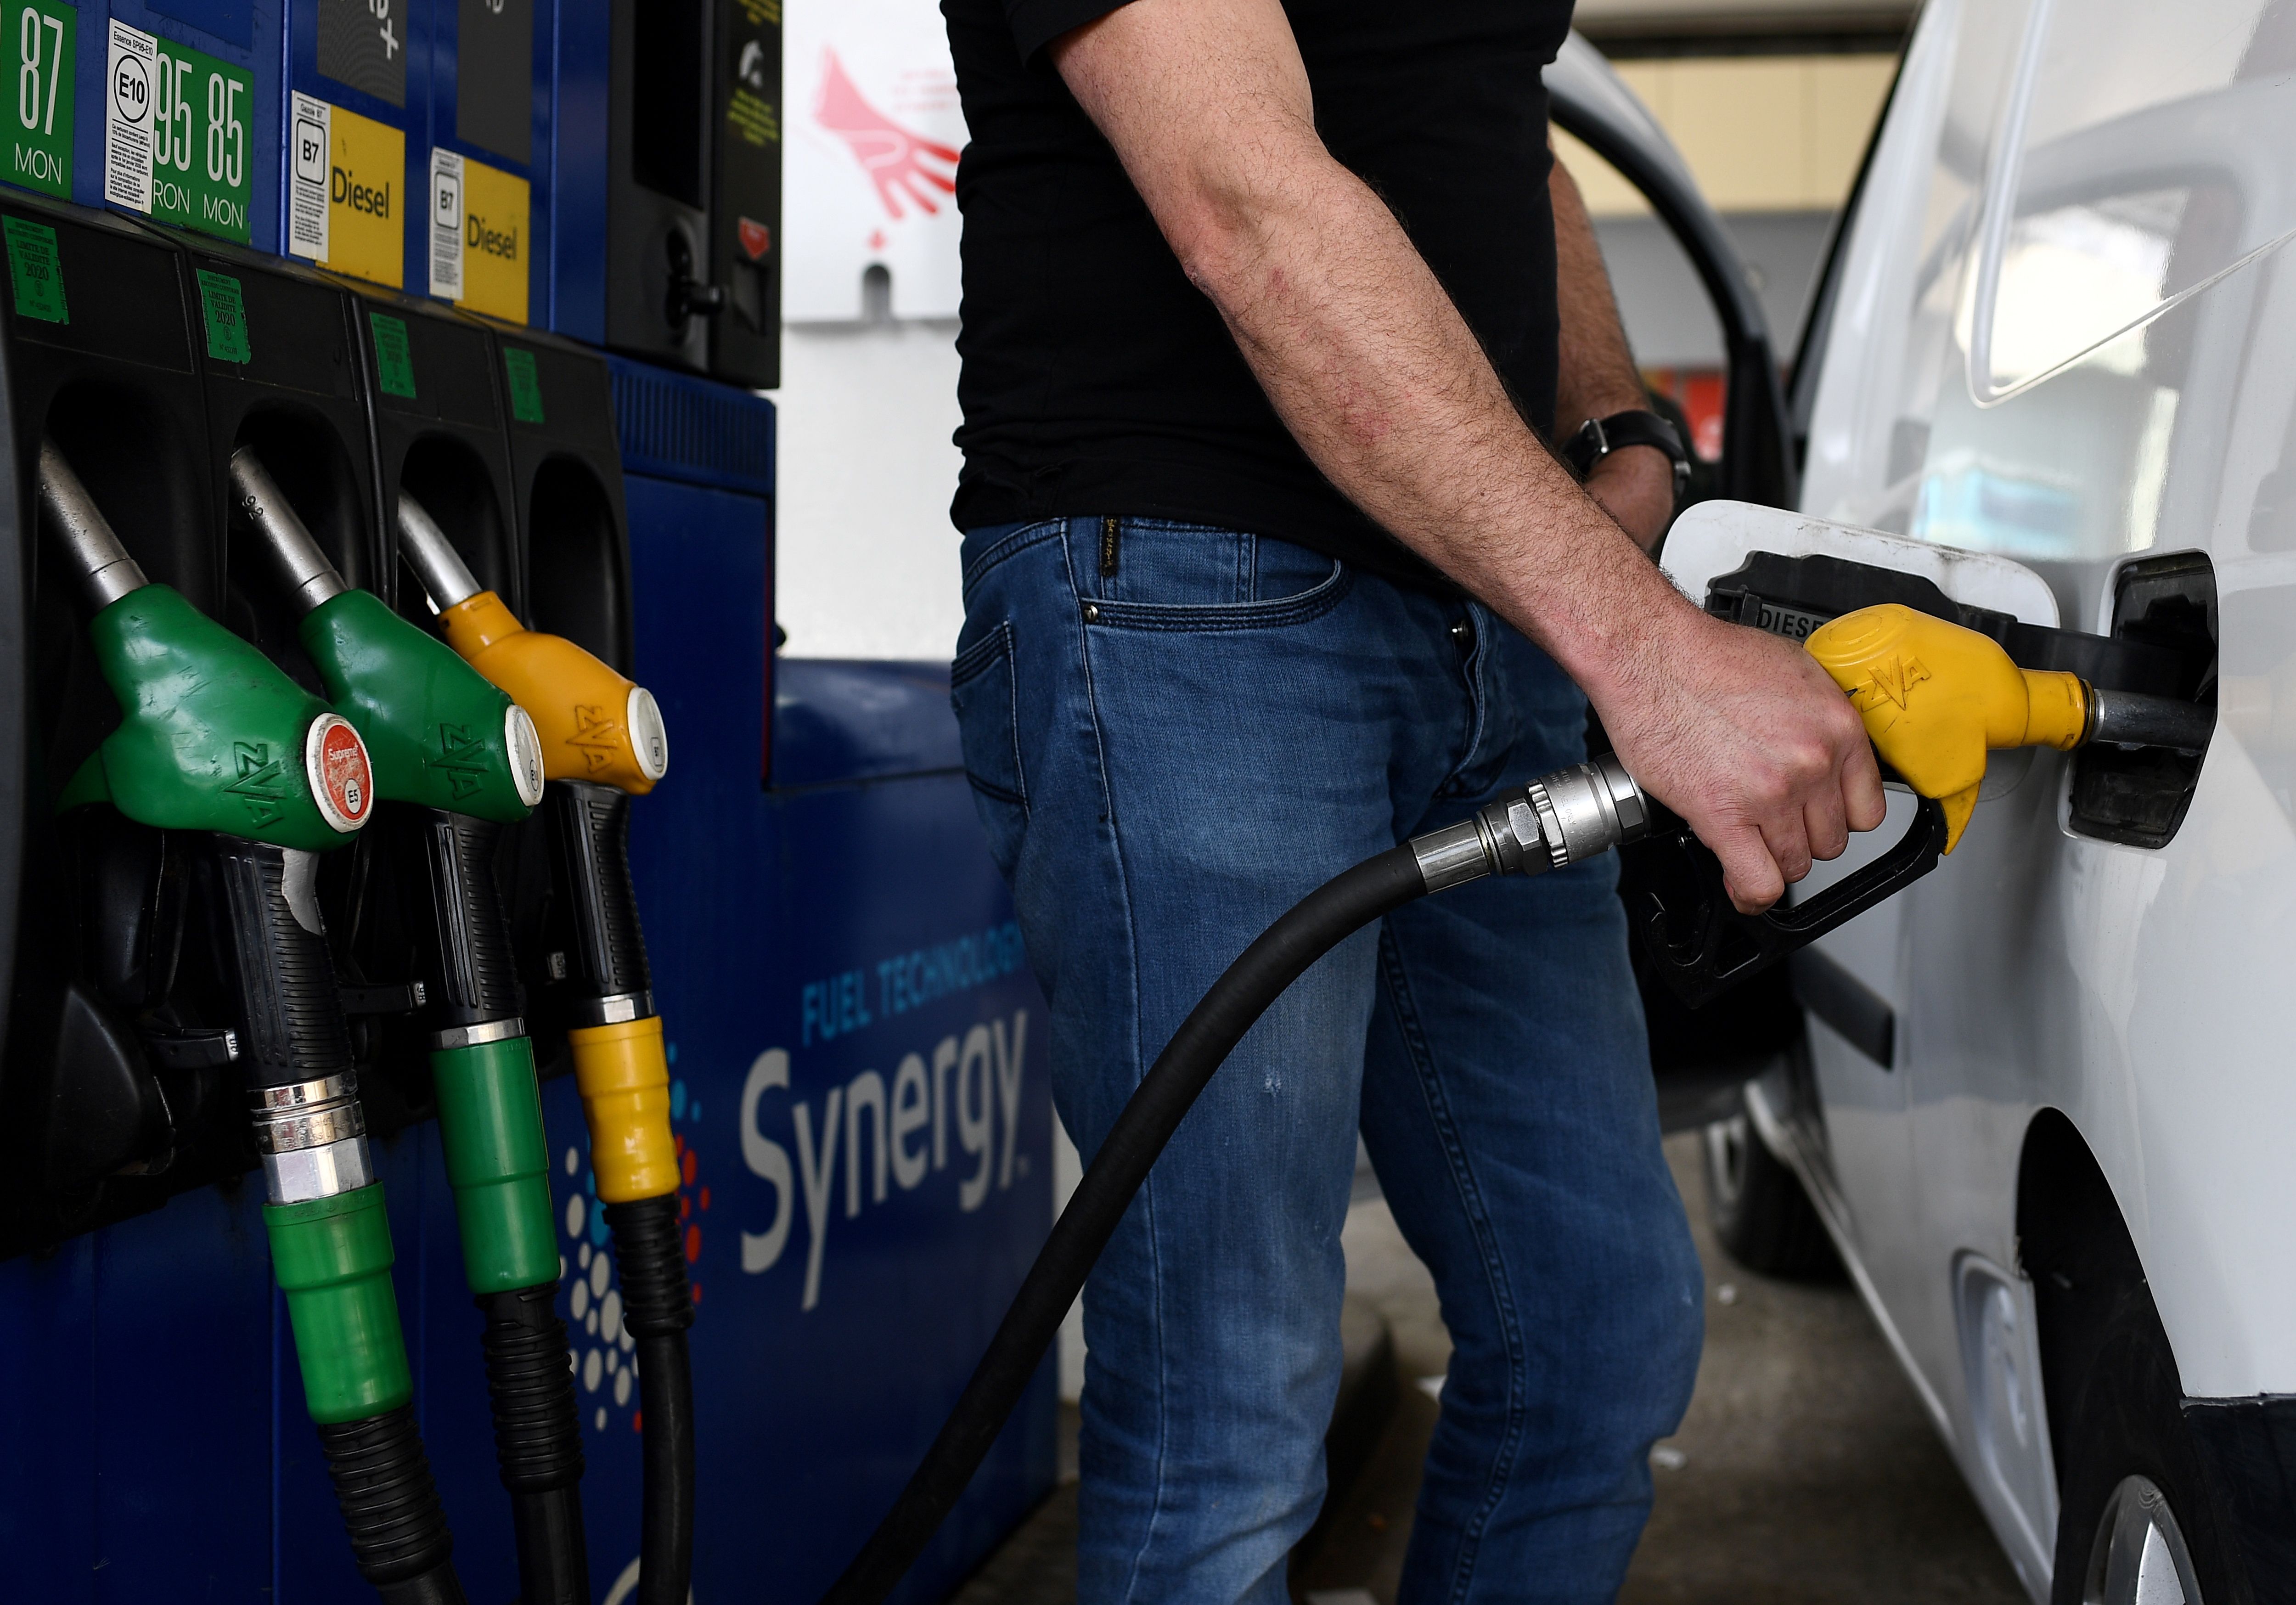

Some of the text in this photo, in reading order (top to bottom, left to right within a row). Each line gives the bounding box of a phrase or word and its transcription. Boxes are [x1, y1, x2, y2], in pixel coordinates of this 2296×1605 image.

[113, 30, 153, 56] Essence SP95-E10
[20, 7, 63, 135] 87
[119, 72, 145, 104] E10
[155, 52, 244, 187] 95 85
[15, 143, 62, 185] MON
[303, 139, 319, 163] B7
[153, 180, 243, 230] RON MON
[332, 165, 389, 220] Diesel
[440, 190, 454, 211] B7
[468, 213, 517, 261] Diesel
[24, 262, 49, 281] 2020
[215, 310, 236, 327] 2020
[1756, 609, 1825, 638] DIESE
[1855, 653, 1932, 713] ZVA
[429, 722, 490, 801] ZVA
[565, 704, 617, 773] ZVA
[222, 741, 287, 829] ZVA
[348, 788, 359, 804] E5
[802, 969, 871, 1049] FUEL
[740, 1008, 1028, 1312] Synergy
